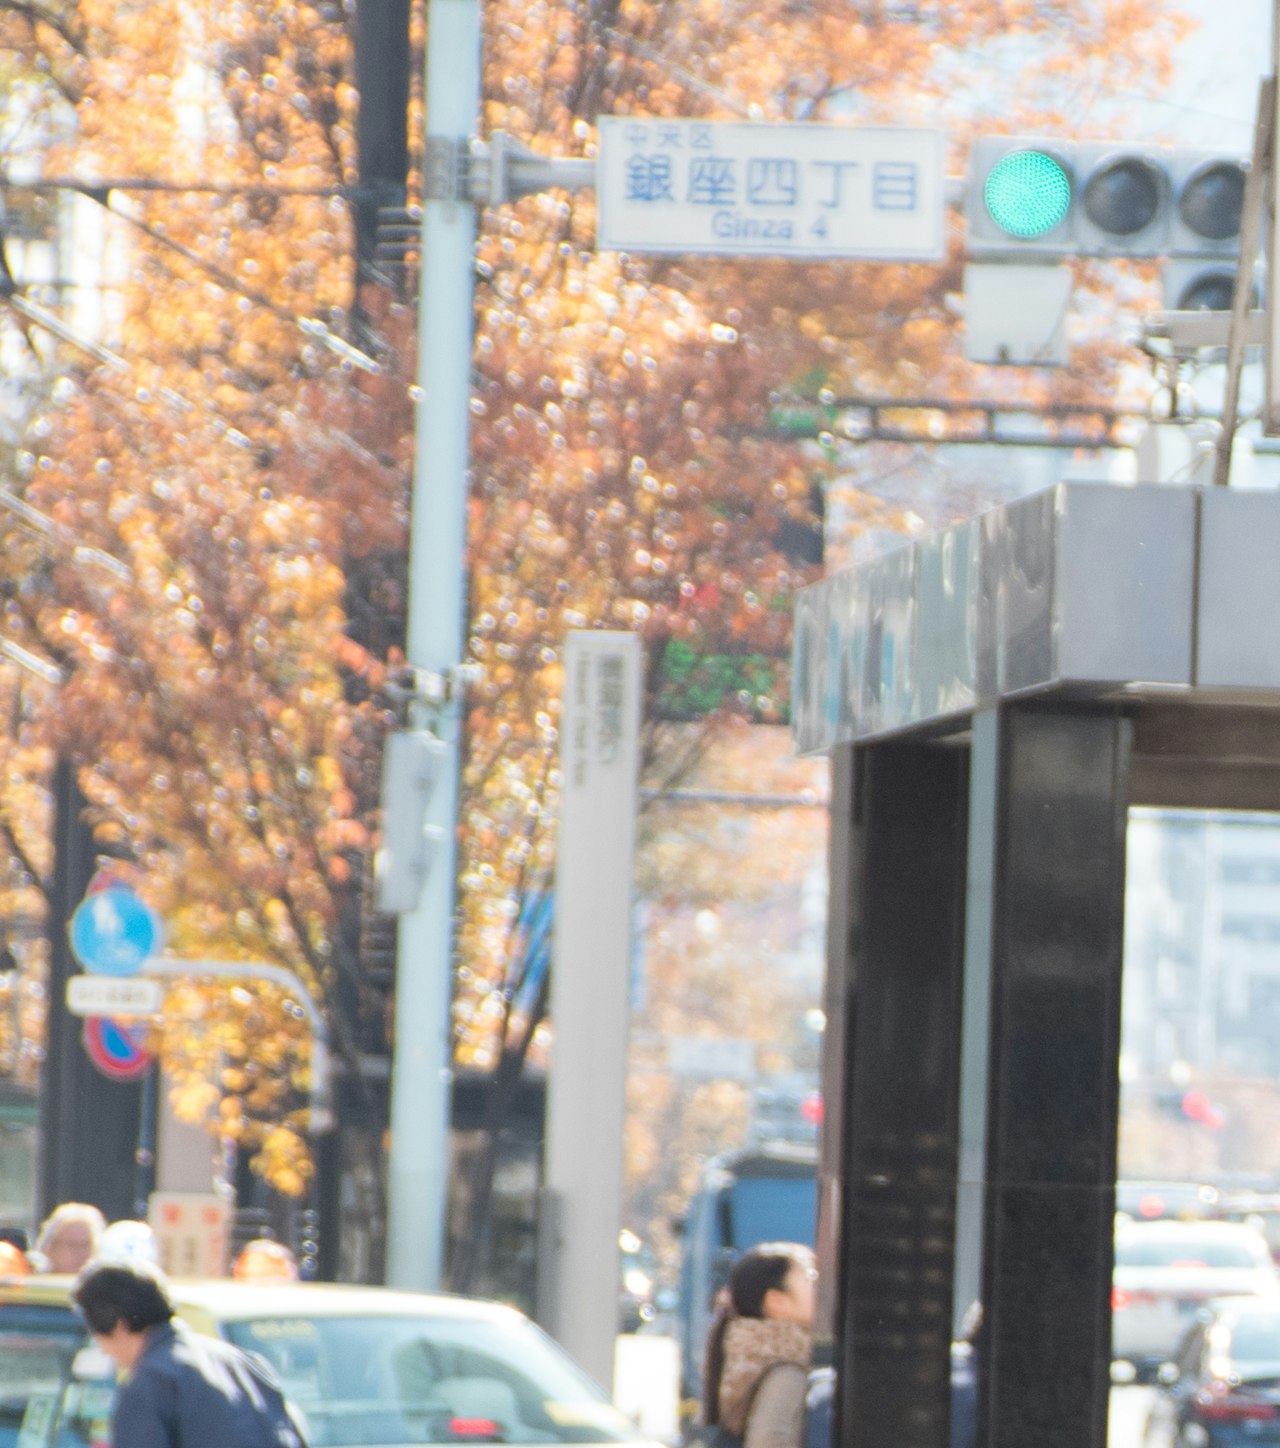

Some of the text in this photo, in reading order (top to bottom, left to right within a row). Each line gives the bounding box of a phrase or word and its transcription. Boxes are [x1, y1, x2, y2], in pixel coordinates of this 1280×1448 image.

[624, 153, 918, 210] 銀座四丁目
[711, 210, 829, 240] Ginza 4
